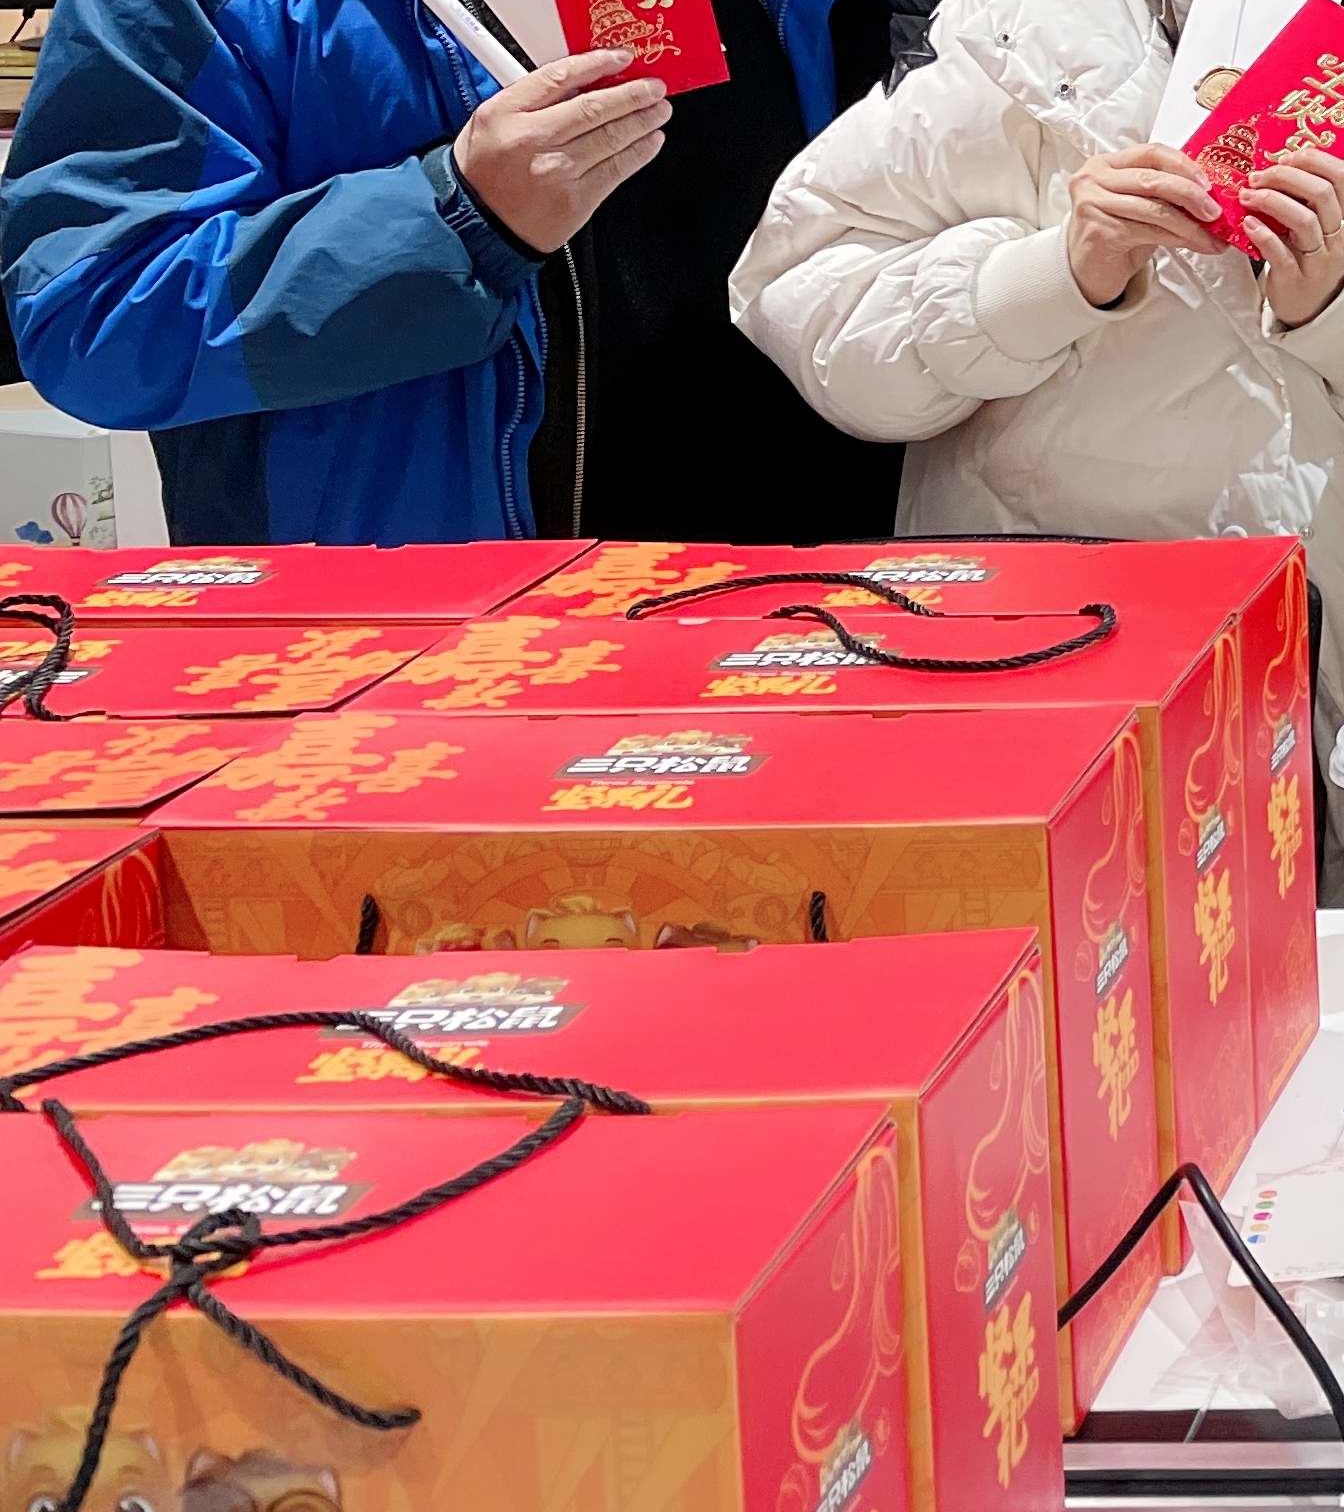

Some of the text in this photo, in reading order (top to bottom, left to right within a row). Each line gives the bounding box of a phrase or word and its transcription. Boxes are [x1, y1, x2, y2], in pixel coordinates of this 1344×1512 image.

[566, 755, 752, 775] 三只松鼠
[91, 1183, 349, 1215] 三只松鼠
